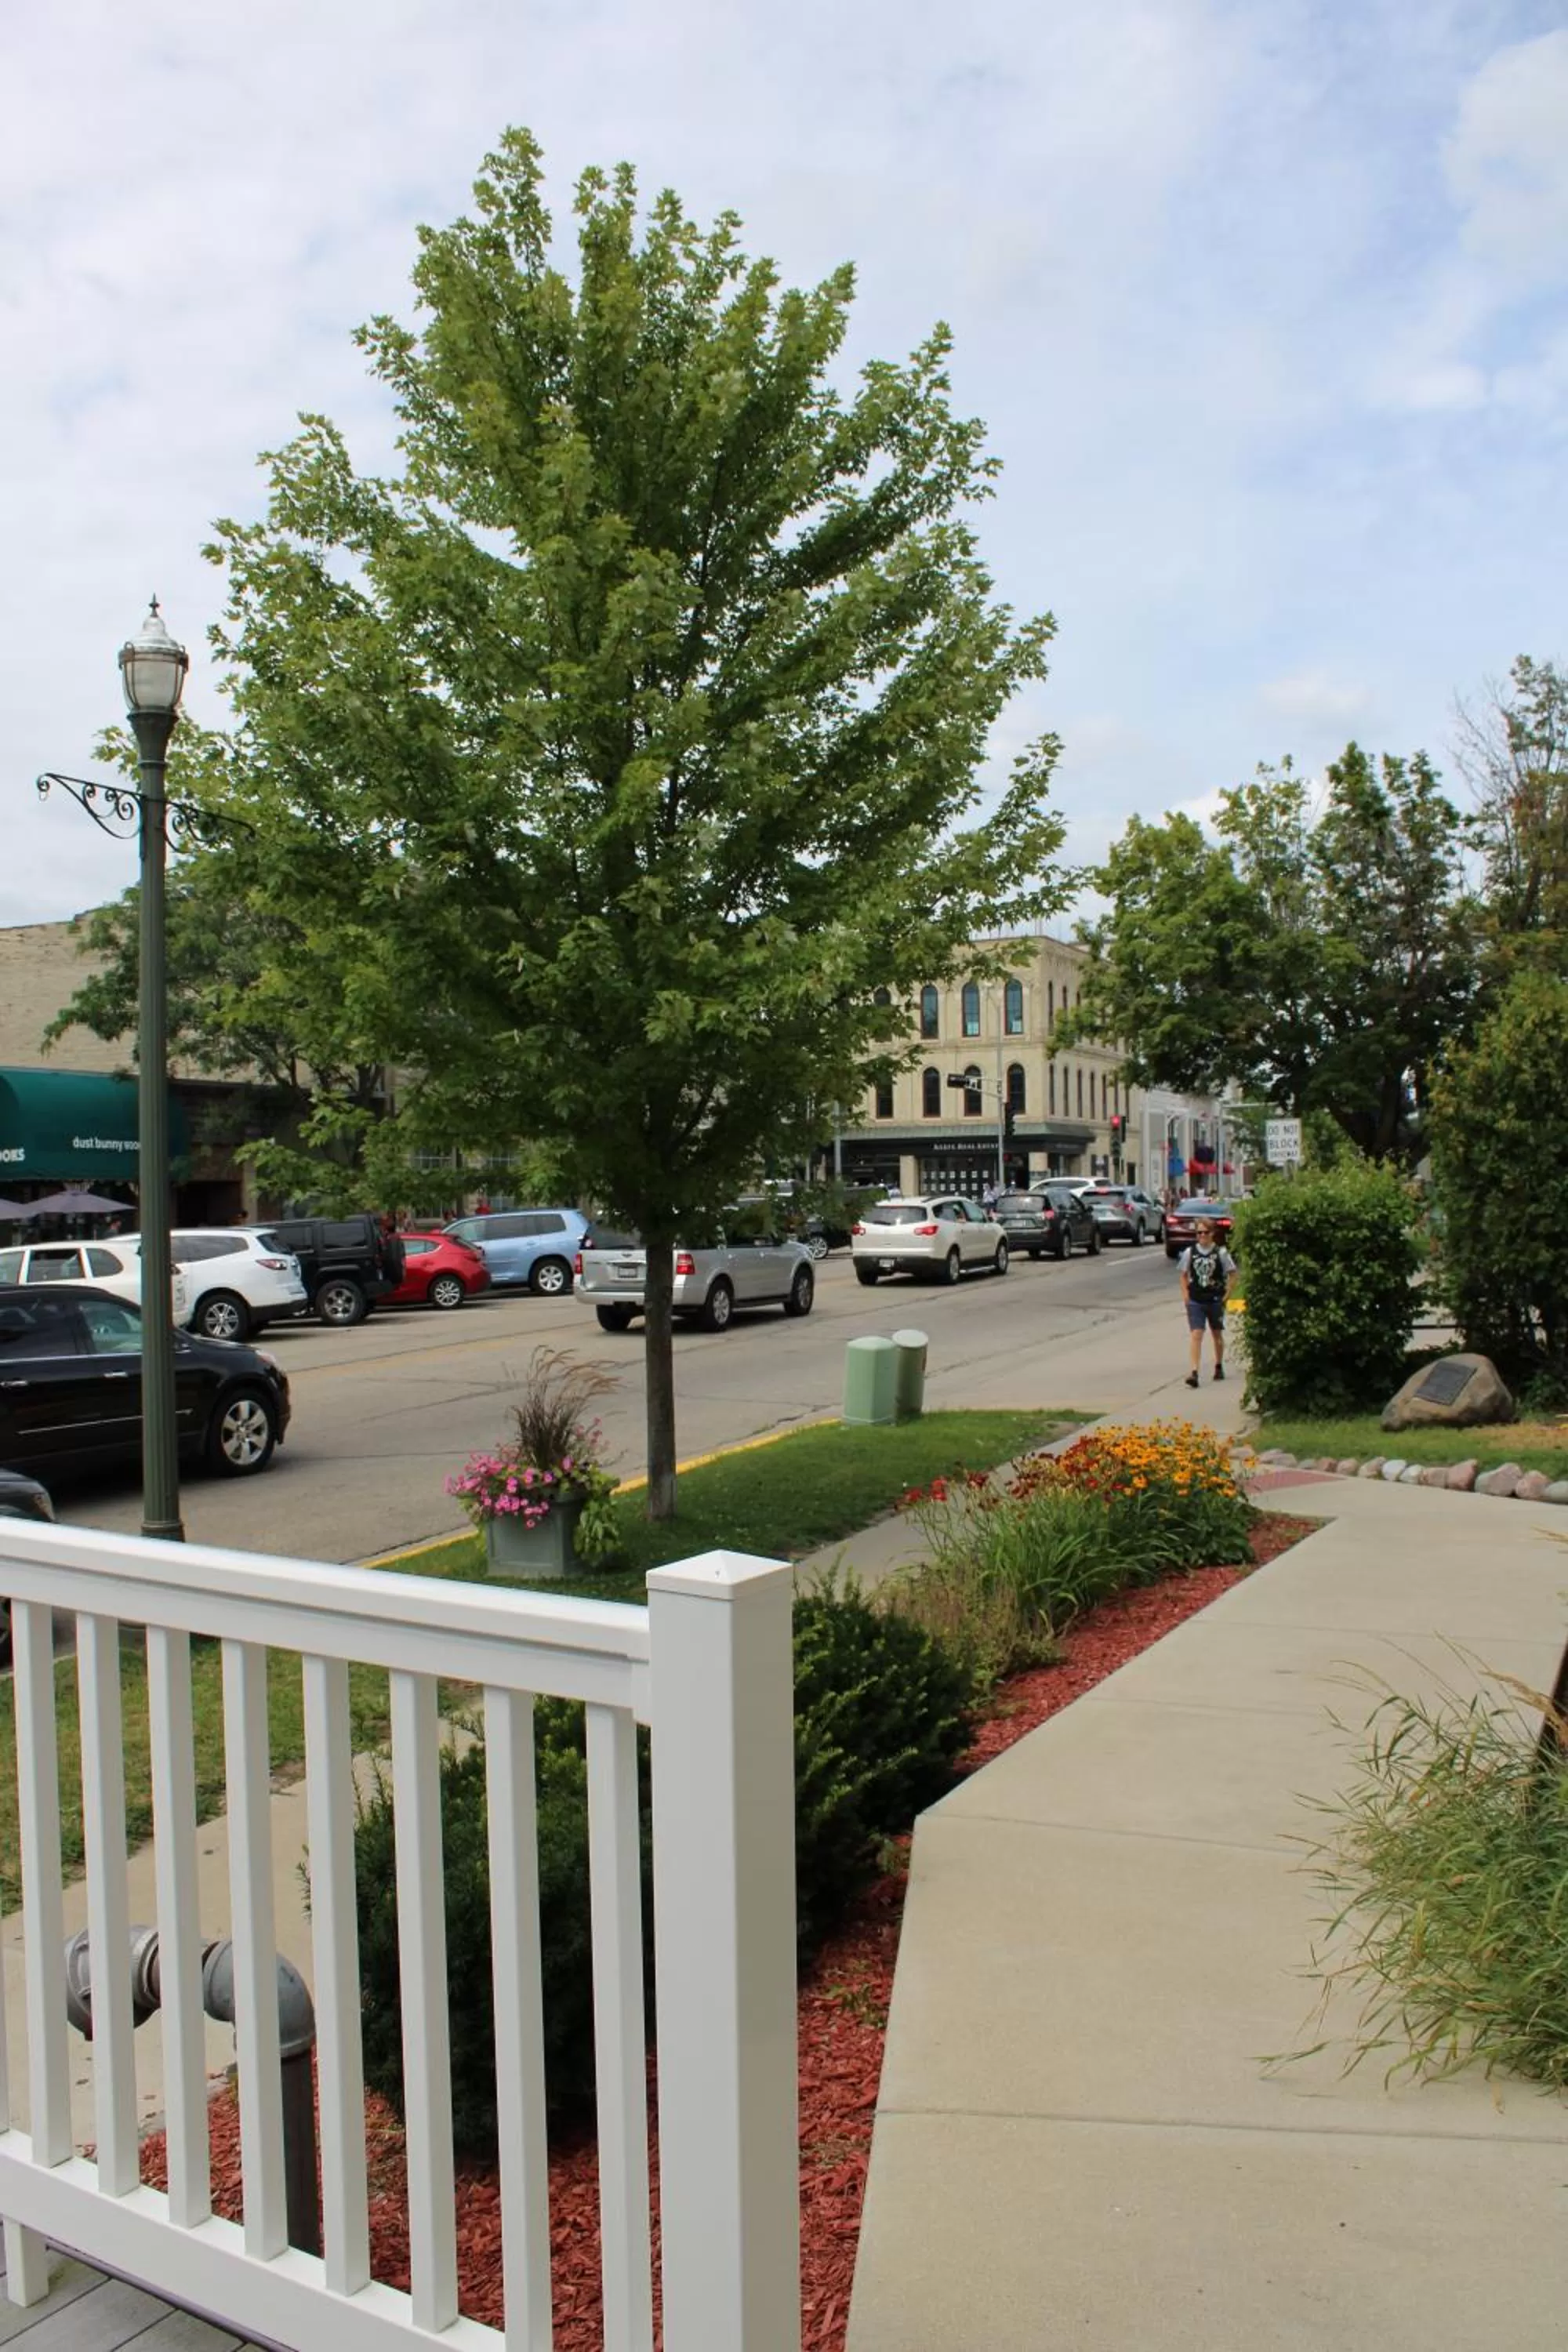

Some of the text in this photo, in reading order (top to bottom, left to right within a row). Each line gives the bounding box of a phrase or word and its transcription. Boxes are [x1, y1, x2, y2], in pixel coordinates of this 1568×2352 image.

[1268, 1124, 1298, 1135] DO NOT
[72, 1137, 94, 1149] dust
[95, 1138, 122, 1152] bunny
[1269, 1138, 1298, 1149] BLOCK
